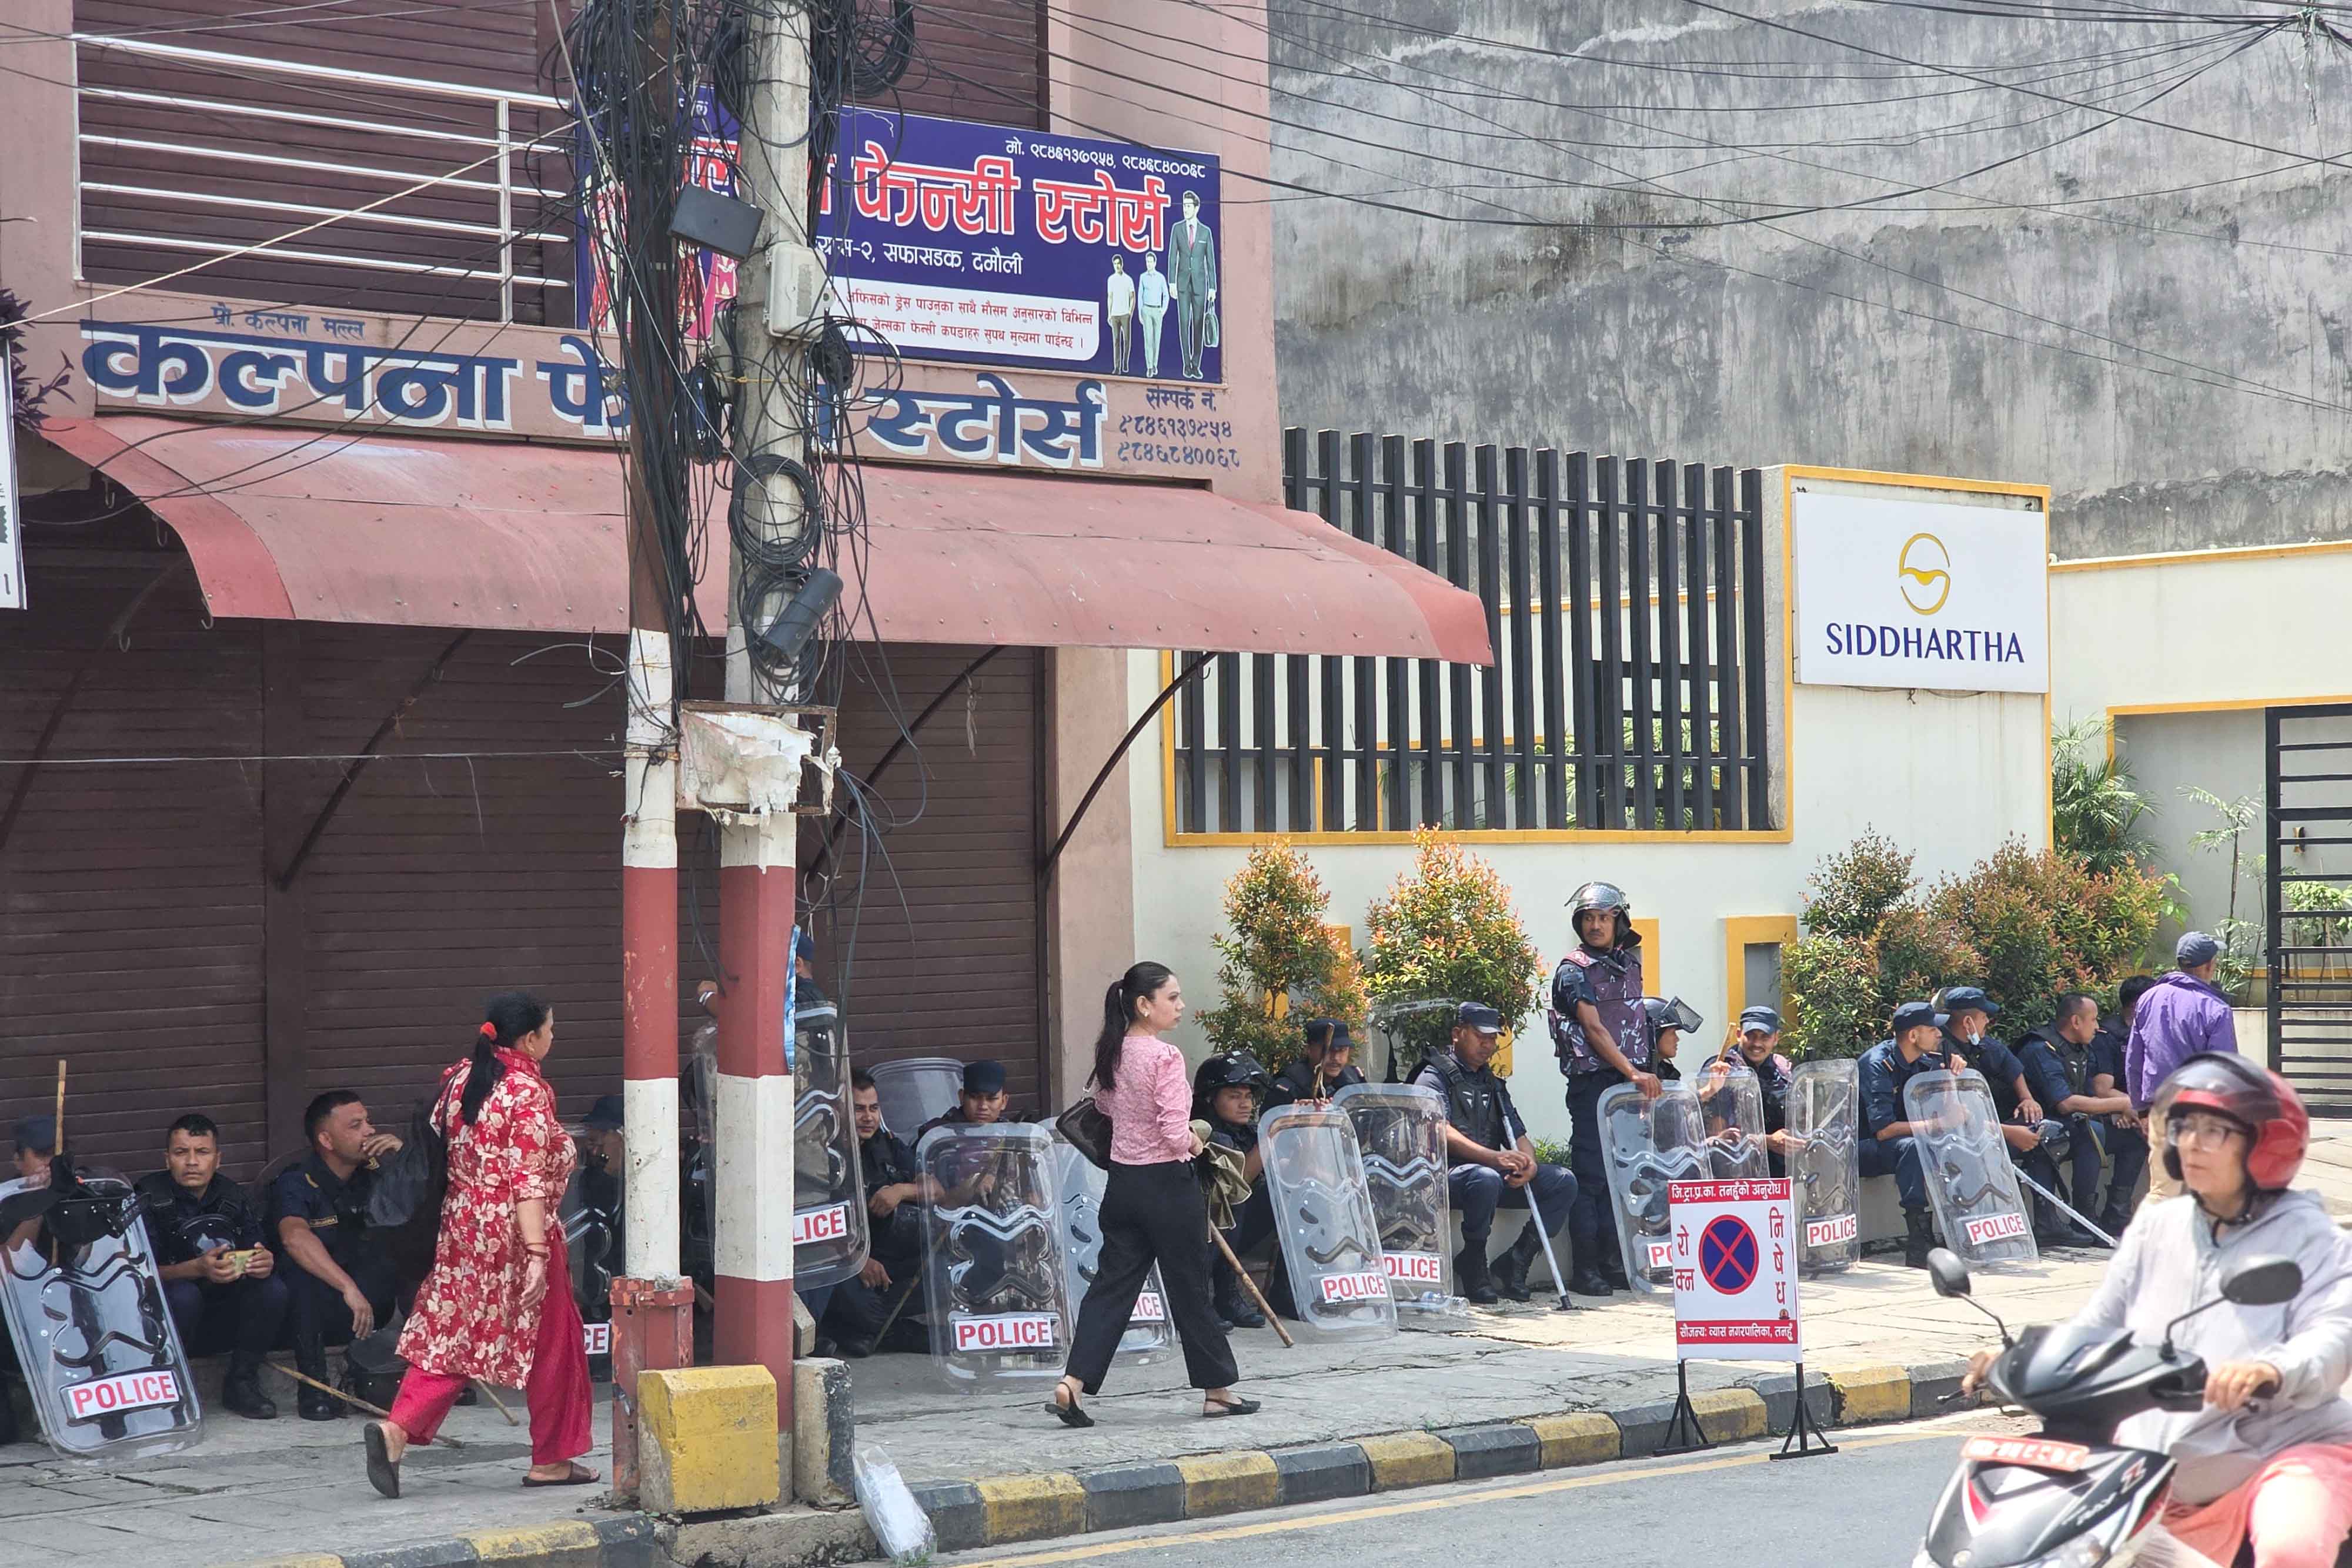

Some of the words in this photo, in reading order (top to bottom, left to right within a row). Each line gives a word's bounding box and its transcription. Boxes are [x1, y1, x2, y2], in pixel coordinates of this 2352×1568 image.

[1005, 136, 1025, 156] मो.
[851, 140, 1021, 235] फेन्सी
[1034, 170, 1172, 253] स्टोर्स
[882, 243, 965, 272] सफासडक,
[972, 246, 1023, 275] दमौली
[244, 310, 310, 336] कल्पना
[320, 317, 365, 339] मल्ल
[916, 298, 954, 315] पाउनुका
[958, 299, 976, 315] साथै
[981, 300, 1008, 317] मौसम
[1013, 307, 1057, 323] अनुसारको
[1061, 309, 1093, 325] विभिन्न
[910, 321, 937, 336] फेन्सी
[984, 329, 1005, 344] सुपथ
[81, 319, 523, 432] कल्पना
[864, 372, 1108, 468] स्टोर्स
[1826, 623, 2025, 663] SIDDHARTHA
[1809, 1216, 1856, 1244] POLICE
[1970, 1215, 2024, 1243] POLICE
[1324, 1273, 1385, 1299] POLICE
[960, 1320, 1050, 1348] POLICE
[1709, 1326, 1726, 1337] व्यास
[1729, 1323, 1773, 1338] नगरपालिका,
[72, 1376, 176, 1416] POLICE
